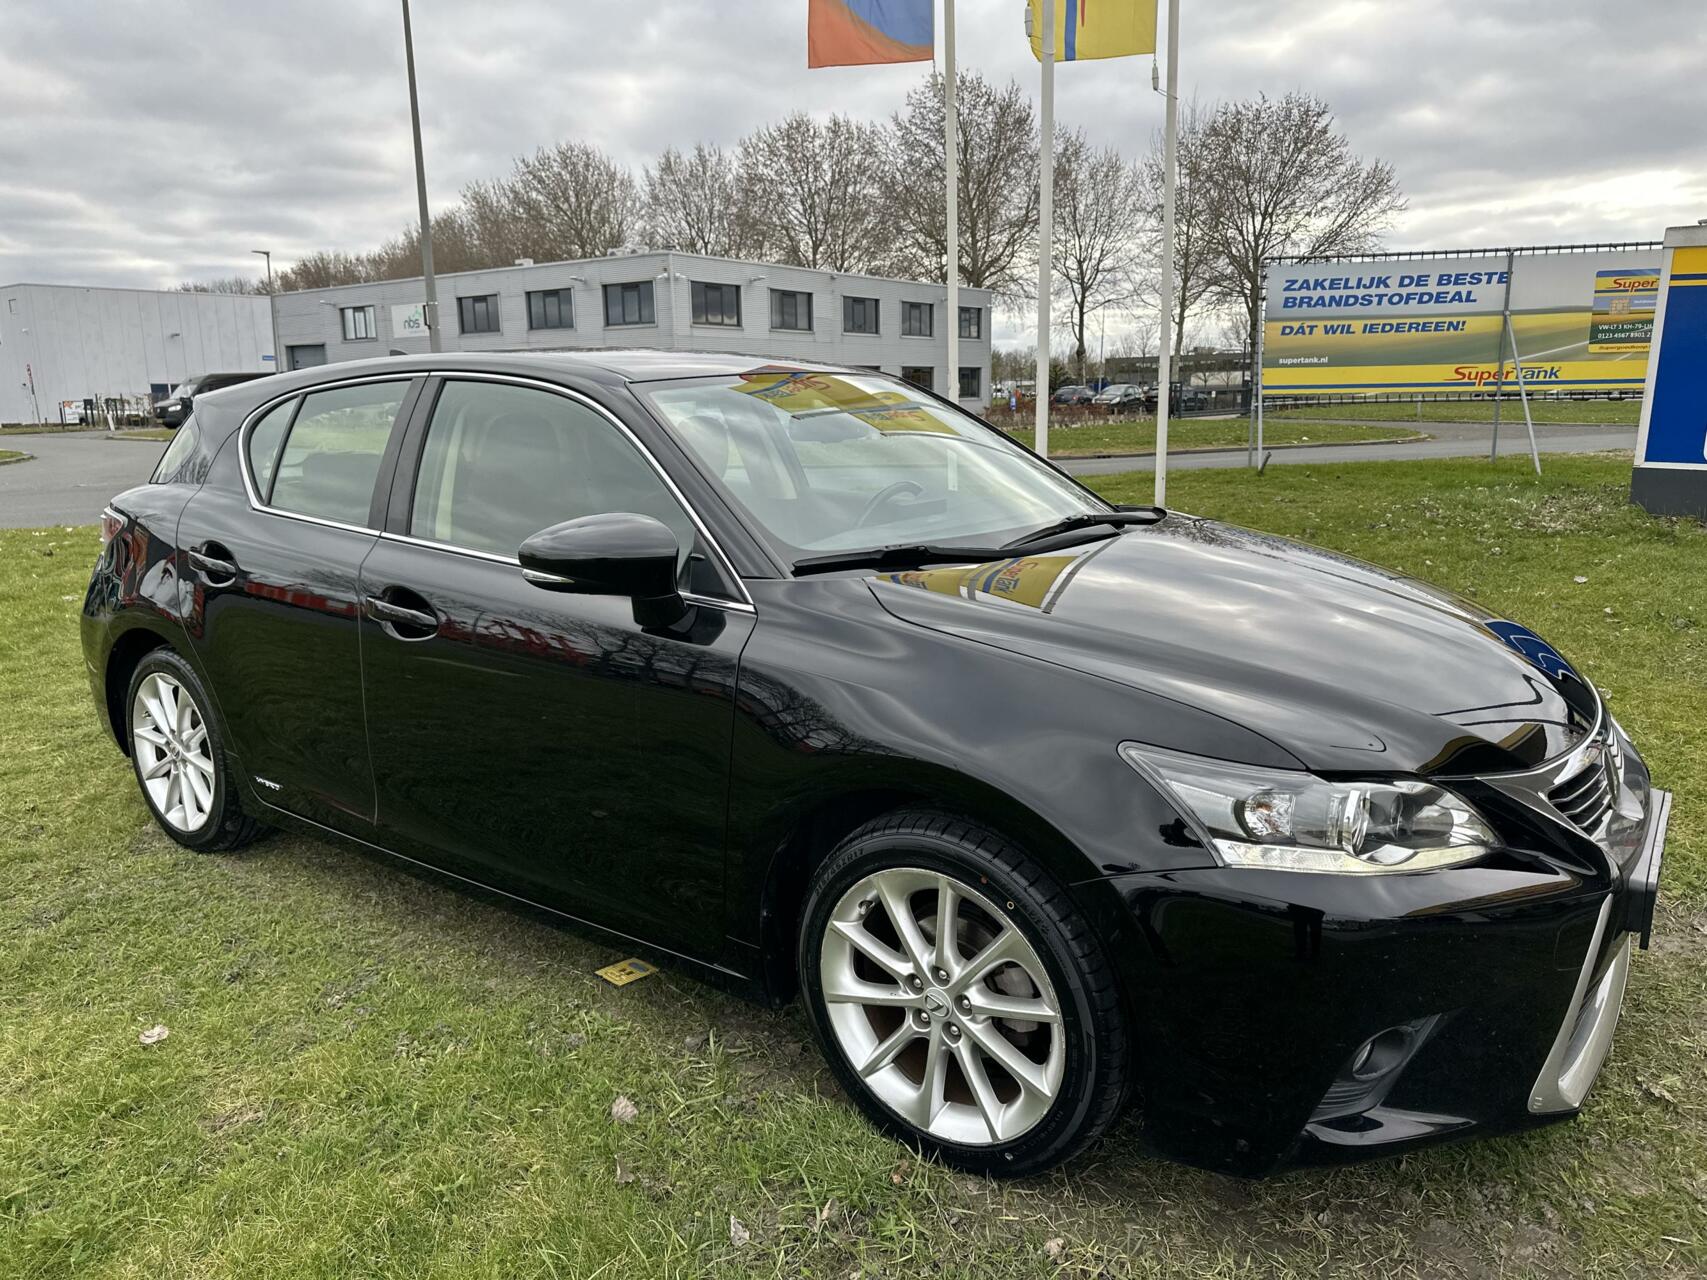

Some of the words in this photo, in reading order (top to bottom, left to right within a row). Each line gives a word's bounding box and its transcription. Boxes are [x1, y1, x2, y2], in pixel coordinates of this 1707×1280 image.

[1282, 275, 1392, 292] ZAKELIJK
[1398, 274, 1430, 289] DE
[1436, 271, 1509, 287] BESTE
[1607, 278, 1658, 293] Super
[1282, 290, 1477, 309] BRANDSTOFDEAL
[1280, 322, 1318, 336] DÁT
[1323, 323, 1356, 336] WIL
[1362, 320, 1467, 335] IEDEREEN!
[1279, 356, 1329, 365] supertank.nl
